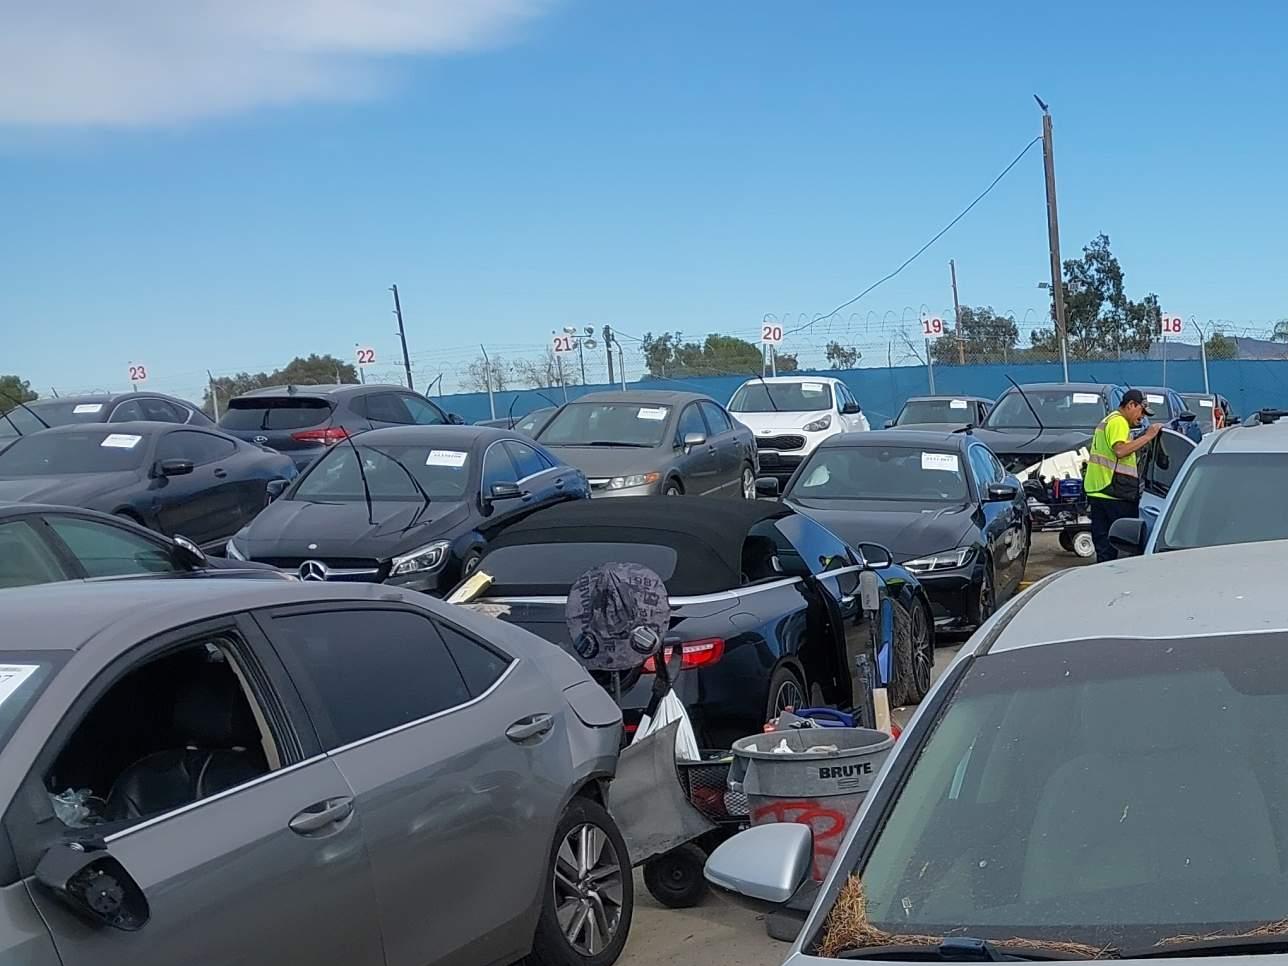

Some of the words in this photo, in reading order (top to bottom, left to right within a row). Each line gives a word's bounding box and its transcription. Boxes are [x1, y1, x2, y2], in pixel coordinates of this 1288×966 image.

[923, 319, 942, 334] 19
[1163, 318, 1182, 333] 18
[762, 326, 781, 341] 20
[553, 337, 571, 352] 21
[357, 349, 375, 364] 22
[129, 366, 146, 380] 23
[818, 763, 873, 779] BRUTE
